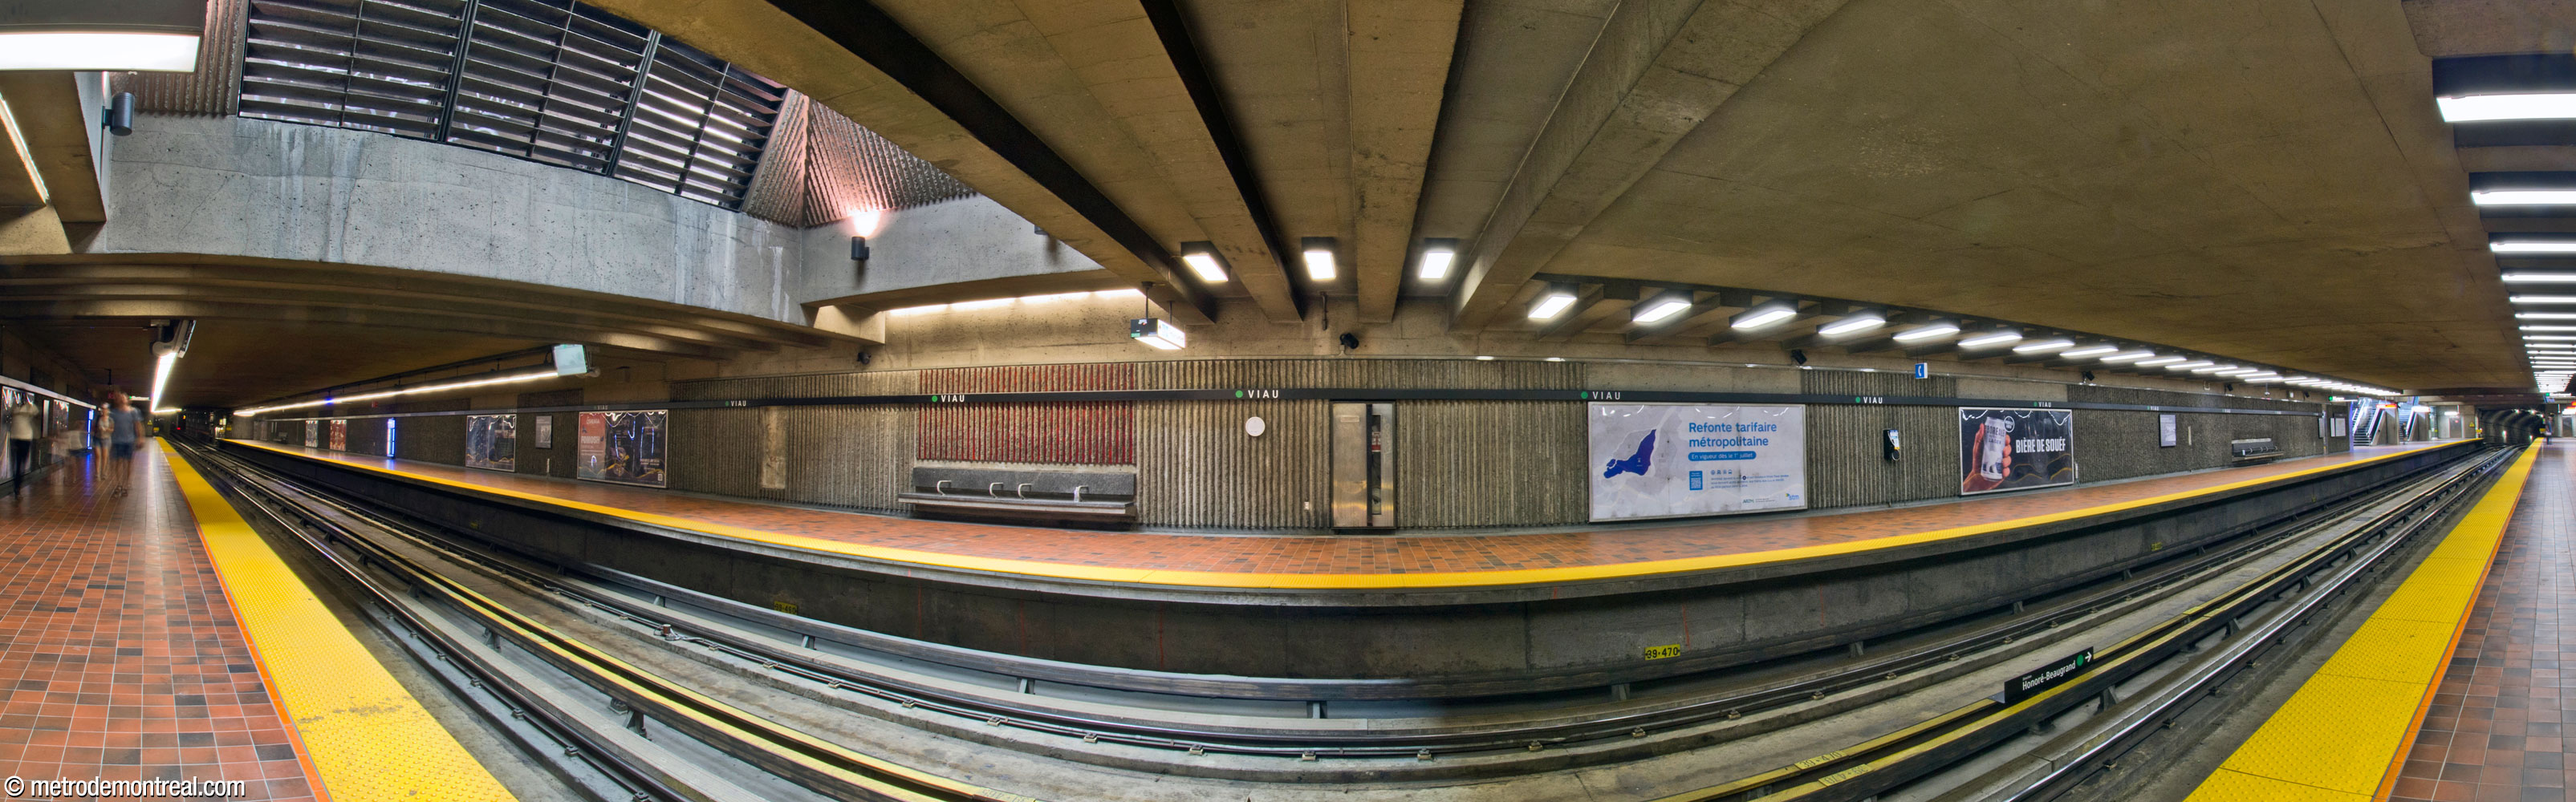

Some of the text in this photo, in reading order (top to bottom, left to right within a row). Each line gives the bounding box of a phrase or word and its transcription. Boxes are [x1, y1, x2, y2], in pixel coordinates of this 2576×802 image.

[941, 395, 965, 403] VIAU
[1248, 390, 1278, 399] VIAU
[1592, 391, 1621, 400] VIAU
[1863, 396, 1883, 404] VIAU
[1688, 422, 1777, 433] Refonte tarifaire
[1688, 435, 1769, 448] métropolitaine
[2016, 436, 2066, 453] BIÈRE DE SOUÉF
[2022, 659, 2076, 691] Honoré-Beaugrand
